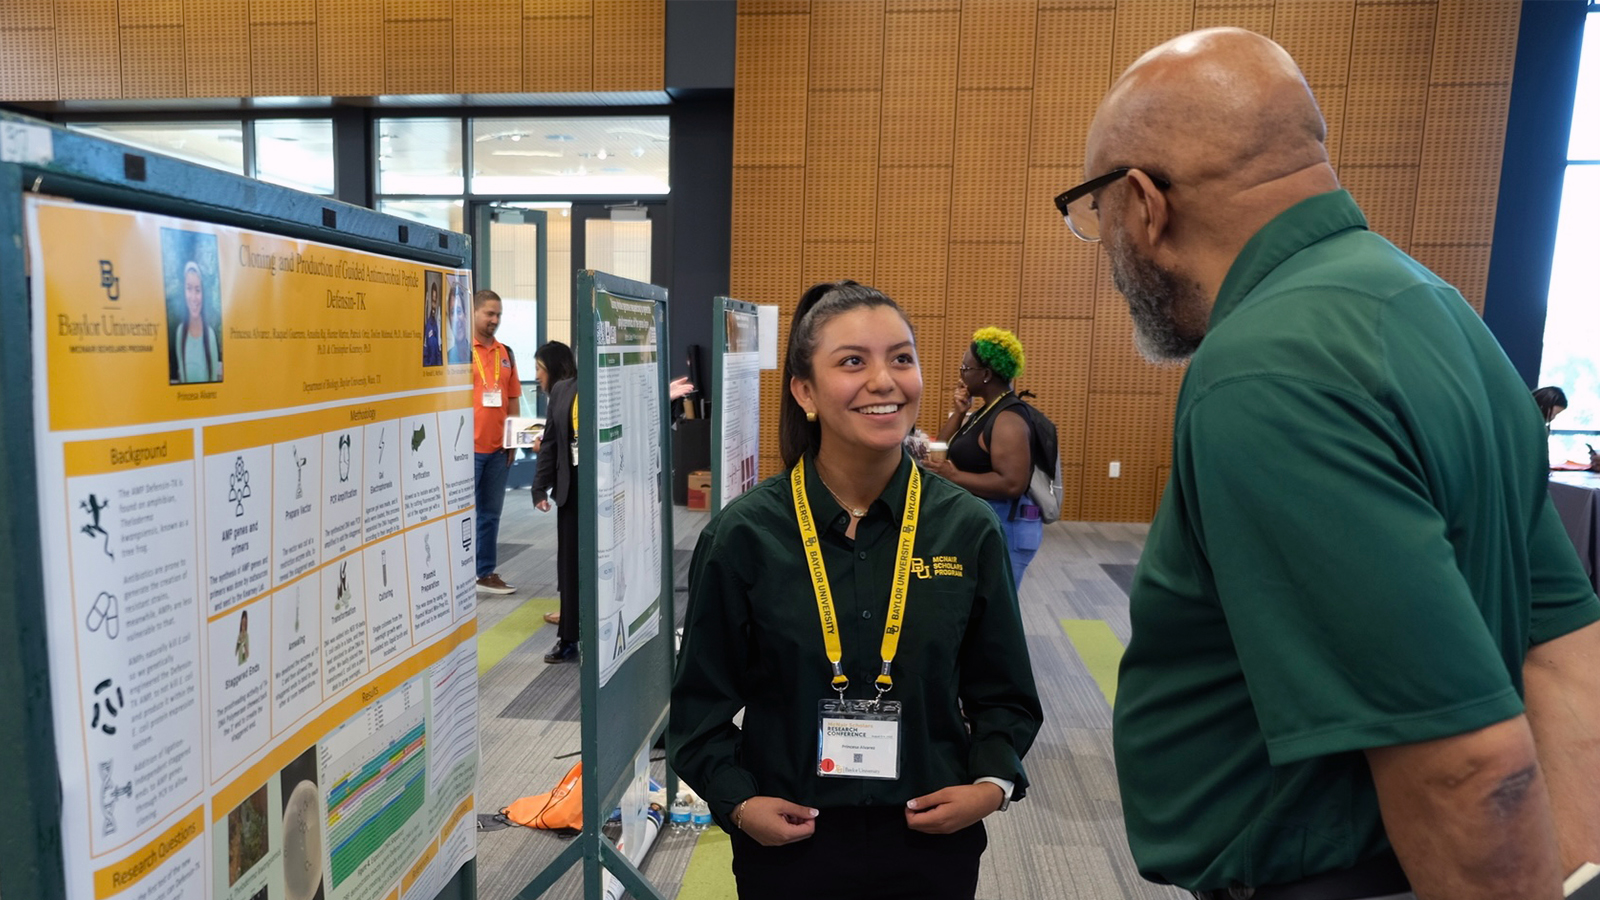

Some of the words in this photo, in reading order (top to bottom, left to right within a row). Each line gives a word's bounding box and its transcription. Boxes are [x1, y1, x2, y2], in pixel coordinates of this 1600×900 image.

[240, 244, 276, 275] Cloning
[278, 254, 294, 272] and
[296, 254, 334, 276] Production
[334, 259, 343, 276] of
[342, 261, 366, 281] Guided
[366, 265, 401, 286] Antimicrobial
[402, 269, 418, 292] Peptide
[58, 314, 101, 341] Baylor
[102, 314, 160, 342] University
[110, 440, 167, 466] Background
[794, 489, 812, 532] UNIVERSITY
[907, 490, 917, 521] BAYLOR
[897, 538, 911, 586] UNIVERSITY
[810, 550, 824, 584] BAYLOR
[817, 584, 835, 635] UNIVERSITY
[892, 588, 903, 620] BAYLOR
[112, 850, 158, 888] Research
[158, 822, 196, 858] Questions
